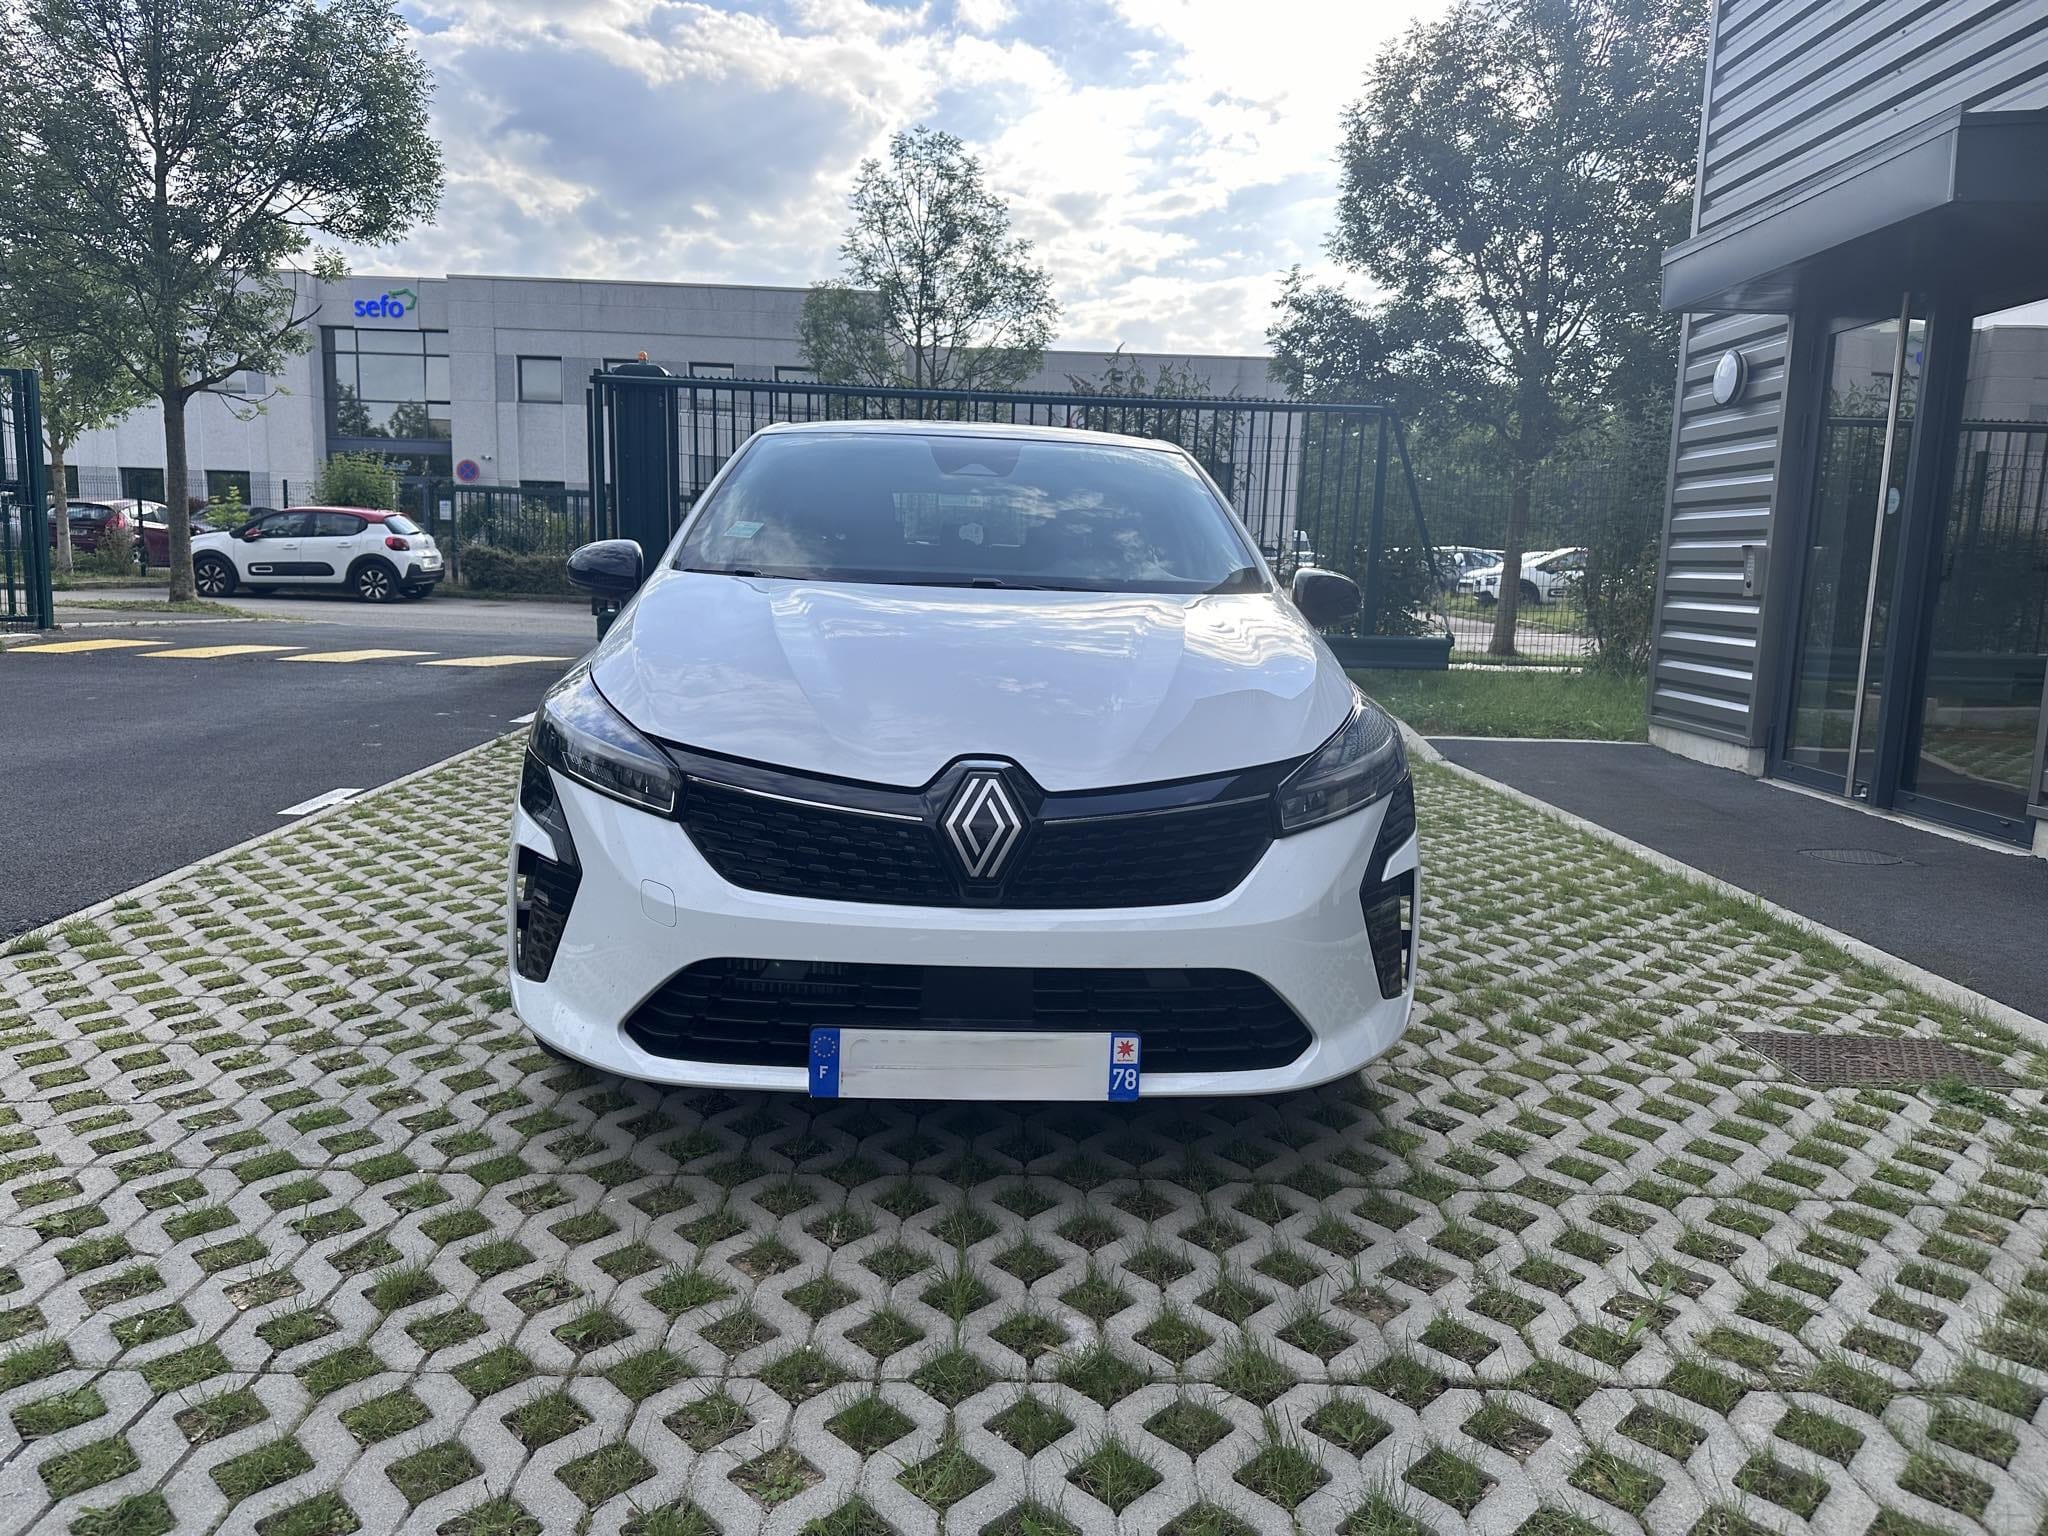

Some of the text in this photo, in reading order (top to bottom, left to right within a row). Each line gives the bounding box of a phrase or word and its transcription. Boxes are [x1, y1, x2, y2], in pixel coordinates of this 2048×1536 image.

[354, 294, 405, 318] sefo
[819, 1065, 829, 1079] F
[1112, 1068, 1137, 1090] 78
